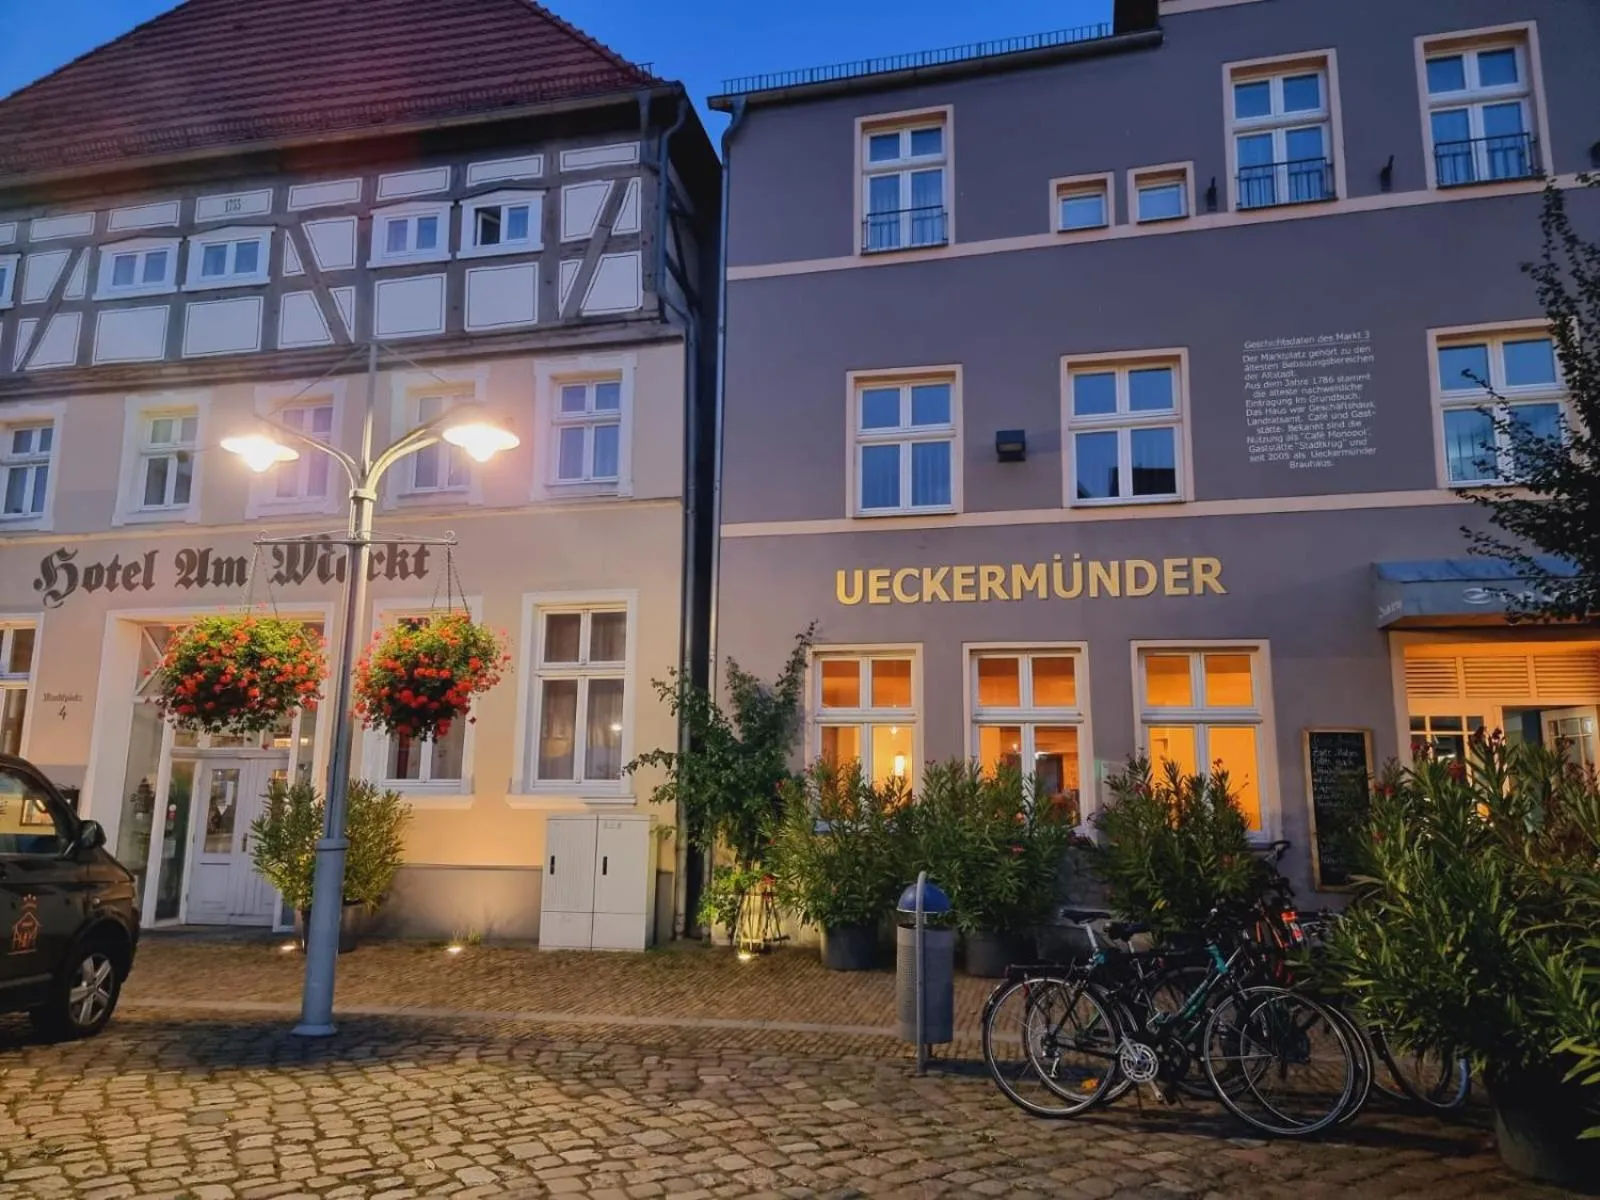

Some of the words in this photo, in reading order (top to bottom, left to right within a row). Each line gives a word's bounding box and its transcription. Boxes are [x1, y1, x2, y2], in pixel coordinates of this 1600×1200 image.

[1317, 334, 1334, 342] des
[1336, 331, 1361, 341] Markt
[1243, 354, 1258, 363] Der
[1353, 345, 1371, 353] den
[1244, 372, 1258, 381] der
[1244, 381, 1261, 389] Aus
[1263, 379, 1282, 388] dem
[1285, 378, 1308, 387] Jahre
[1337, 372, 1371, 383] stammt
[1246, 398, 1292, 408] Eintragung
[1246, 408, 1262, 417] Das
[1265, 407, 1287, 415] Haus
[1290, 406, 1306, 414] war
[1331, 411, 1348, 419] und
[1287, 422, 1323, 432] Bekannt
[1326, 420, 1345, 429] sind
[1348, 420, 1361, 428] die
[1247, 434, 1283, 444] Nutzung
[1349, 438, 1367, 447] und
[33, 547, 158, 608] Hotel
[174, 547, 248, 589] Am
[836, 553, 1227, 605] UECKERMÜNDER
